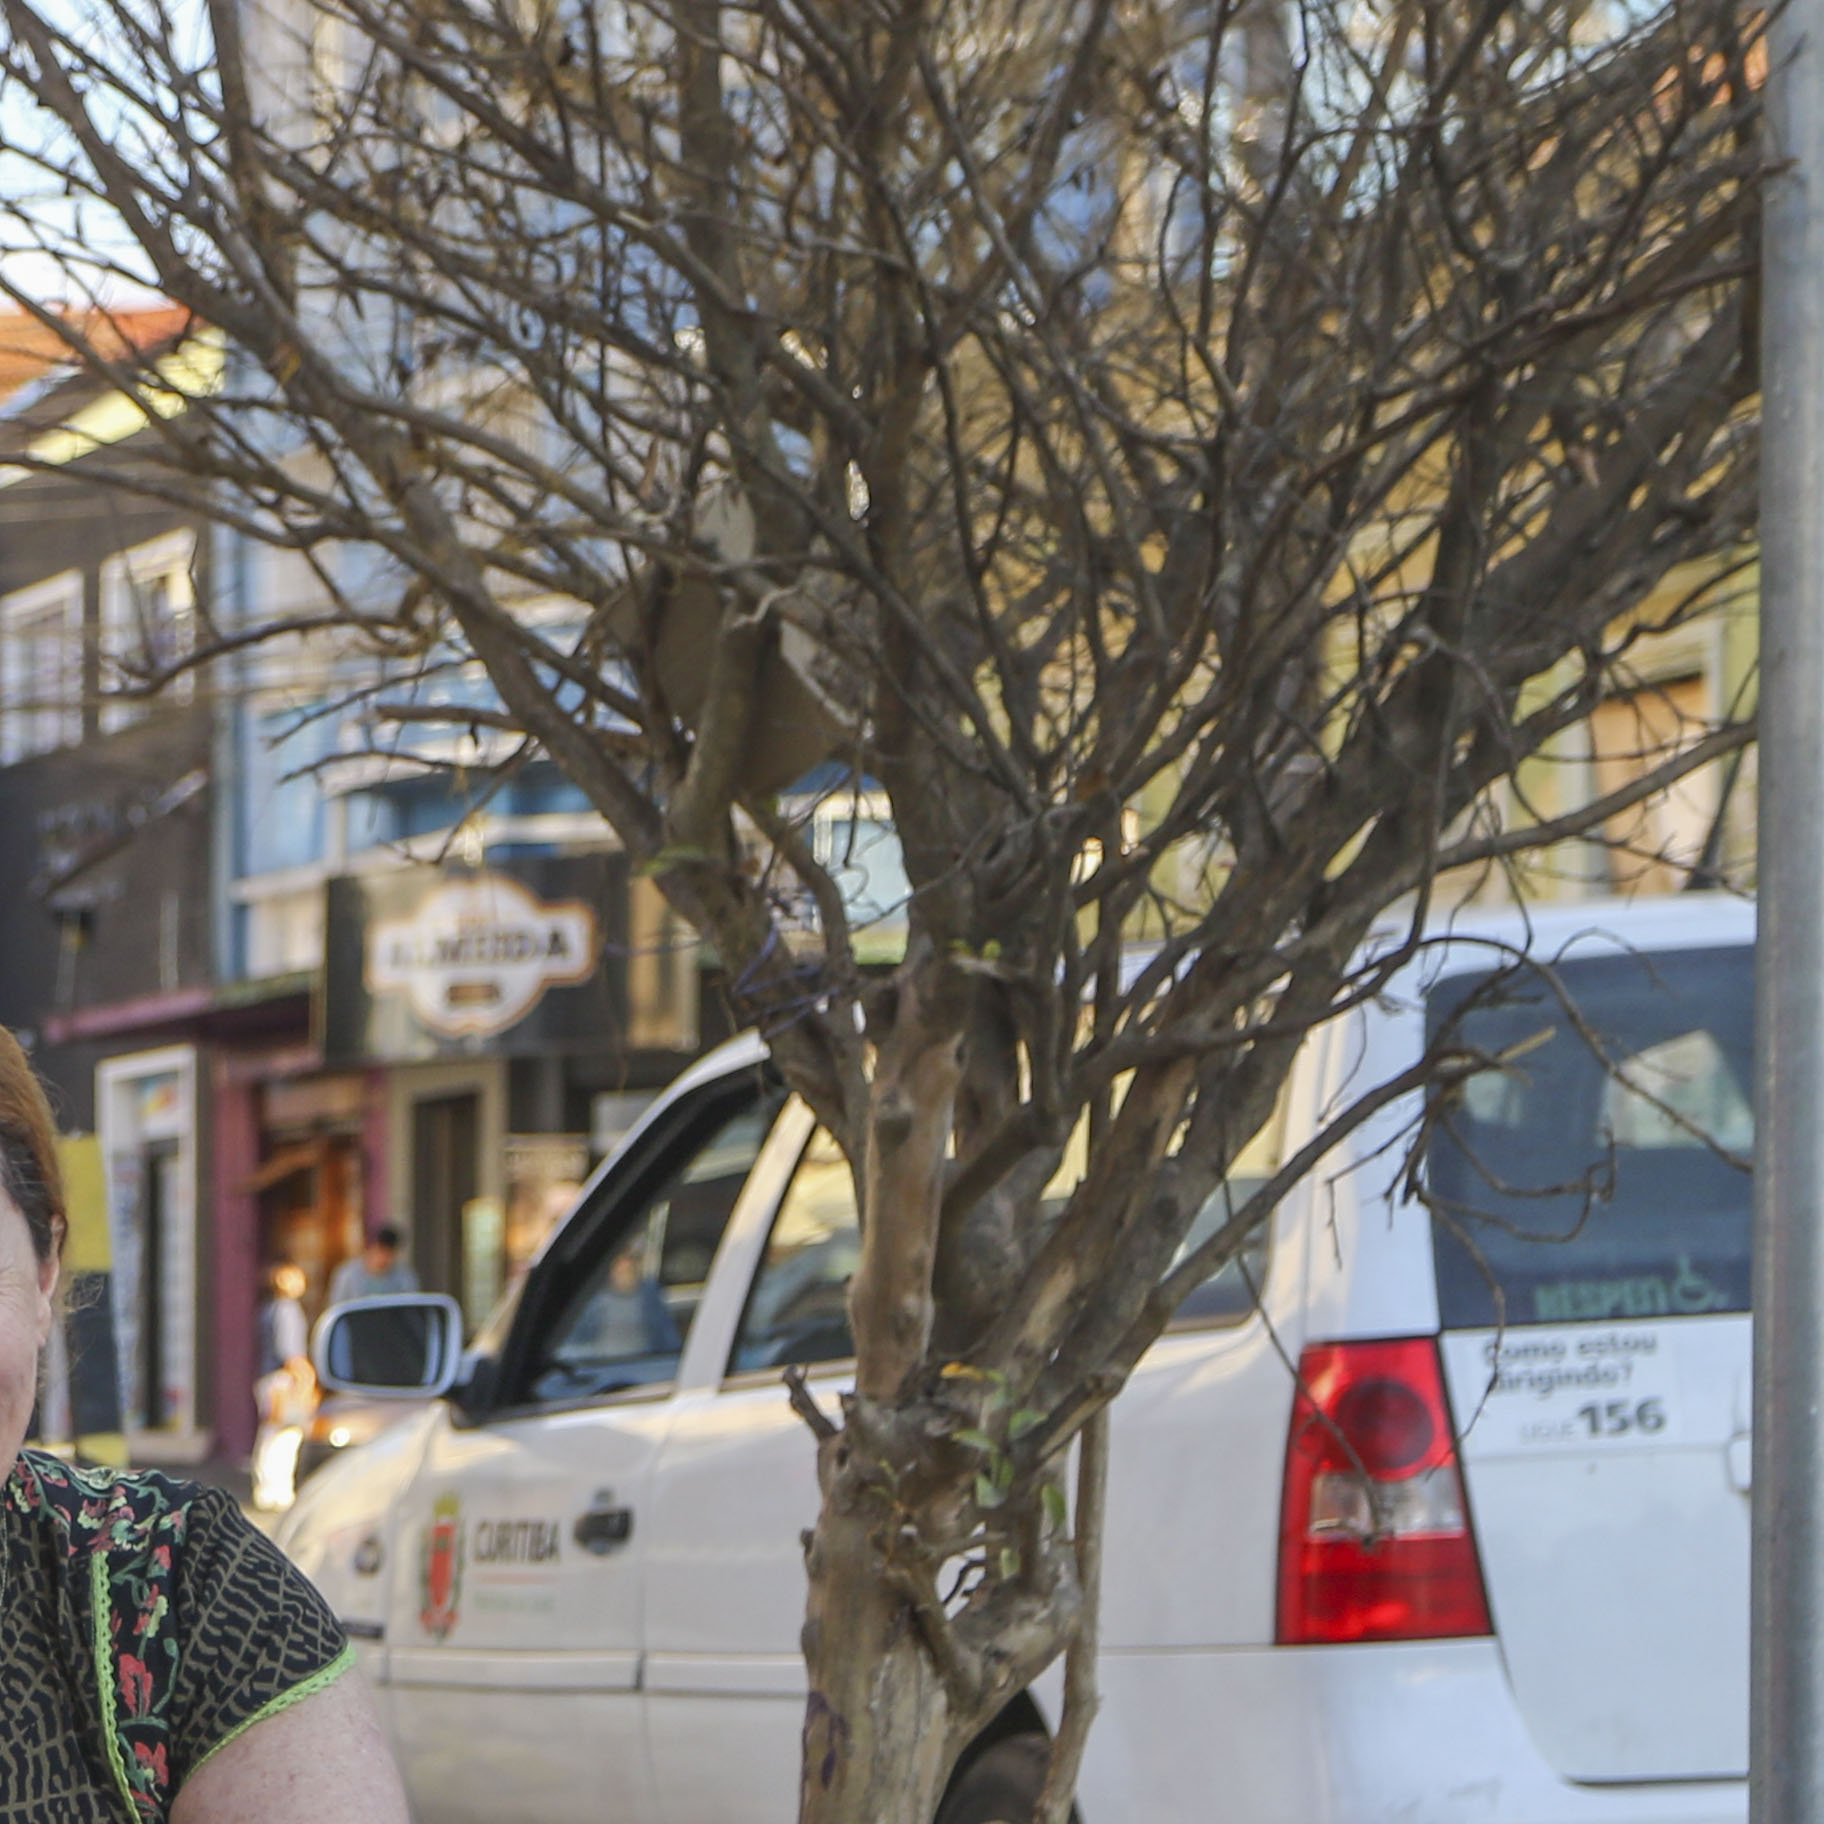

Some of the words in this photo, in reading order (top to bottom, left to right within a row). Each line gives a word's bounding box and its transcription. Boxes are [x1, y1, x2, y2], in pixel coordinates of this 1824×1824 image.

[1577, 1331, 1658, 1355] estou
[1487, 1361, 1633, 1397] irigindo?
[1578, 1397, 1667, 1437] 156
[474, 1519, 562, 1564] CURITIBA
